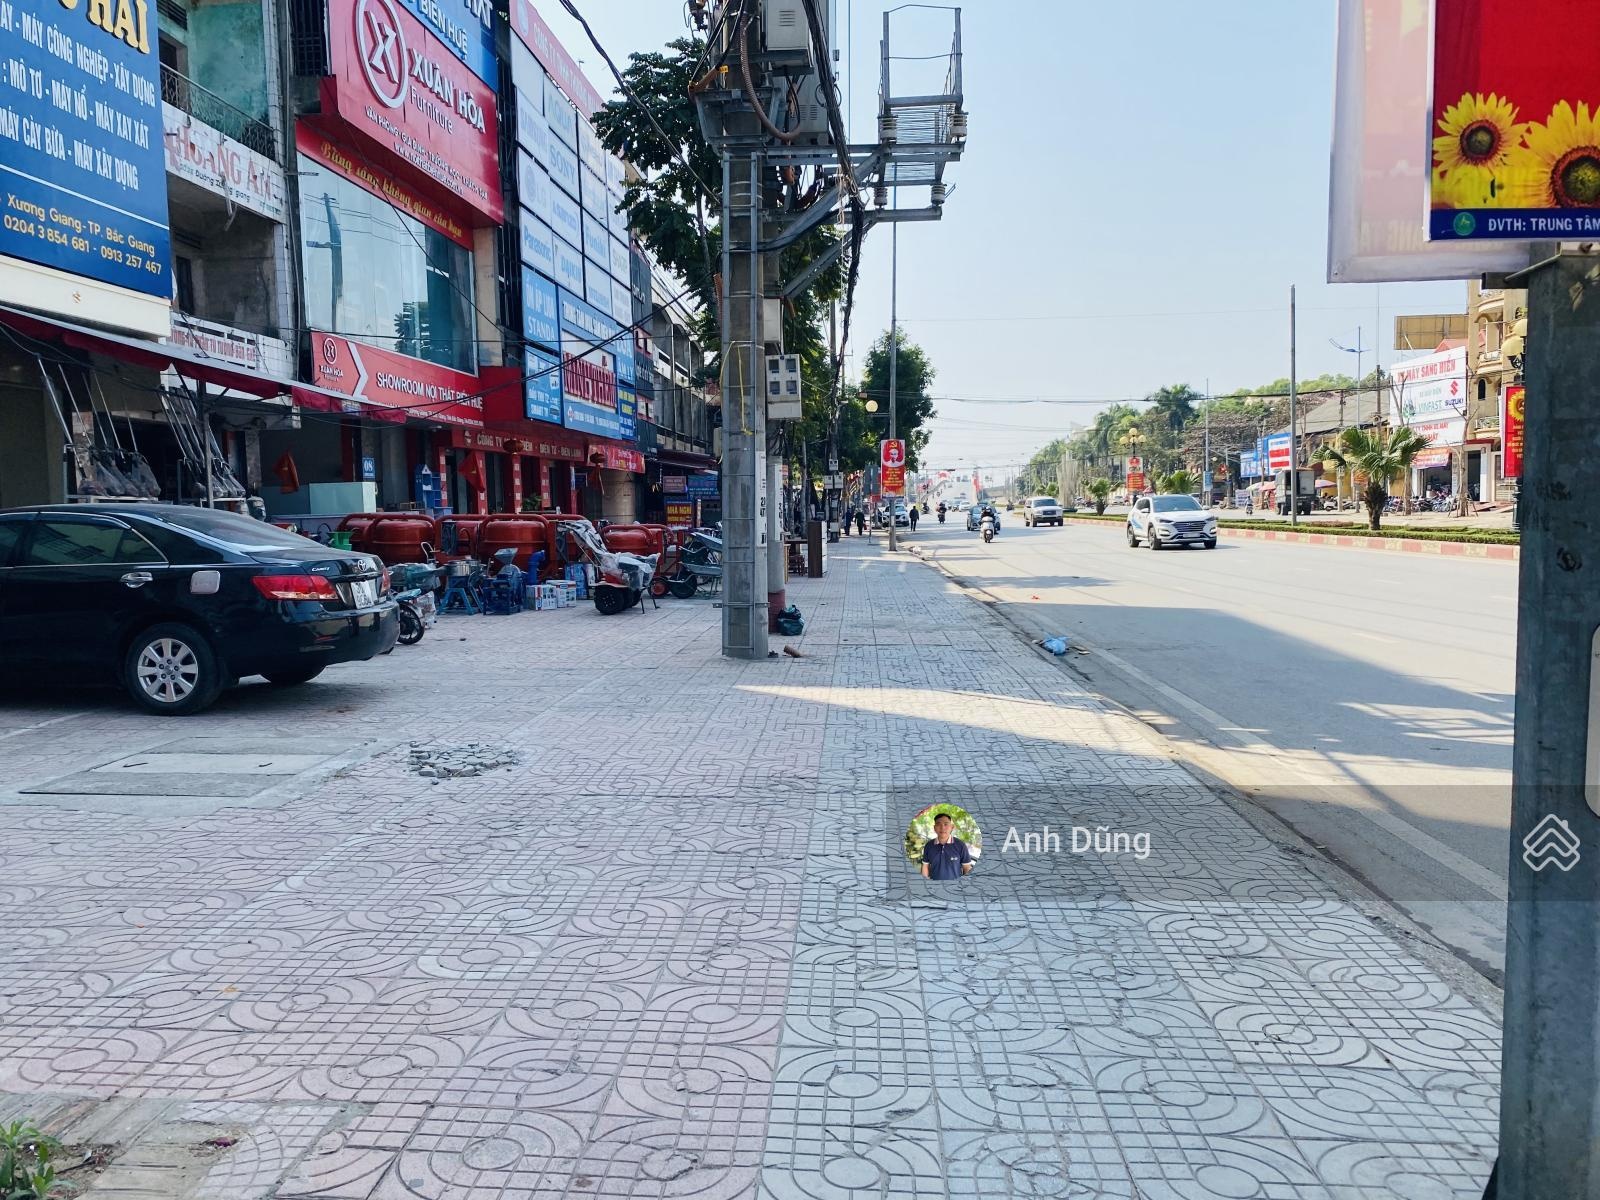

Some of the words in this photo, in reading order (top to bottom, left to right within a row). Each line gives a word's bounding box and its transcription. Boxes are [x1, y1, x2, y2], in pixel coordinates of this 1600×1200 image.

[21, 11, 43, 49] MÁY
[46, 23, 74, 65] CÔNG
[76, 42, 109, 85] NGHIỆP
[113, 61, 130, 94] XÂY
[132, 72, 156, 108] DỰNG
[9, 57, 27, 93] MÔ
[51, 78, 72, 114] MÁY
[73, 83, 88, 121] NỔ
[95, 100, 115, 134] MÁY
[115, 111, 133, 142] XAY
[133, 119, 149, 150] XÁT
[409, 84, 454, 135] Furniture
[411, 47, 454, 108] XUÂN
[457, 88, 486, 134] HÒA
[22, 114, 41, 151] CÀY
[44, 125, 66, 161] BỪA
[73, 138, 93, 172] MÁY
[95, 147, 113, 180] XÂY
[114, 159, 139, 191] DỰNG
[549, 144, 577, 186] SONY
[7, 192, 46, 222] Xương
[1488, 218, 1527, 232] ĐVTH:
[1530, 217, 1573, 231] TRUNG
[3, 213, 36, 237] 0204
[37, 225, 46, 240] 3
[46, 228, 69, 248] 854
[71, 236, 91, 253] 681
[100, 244, 124, 264] 0913
[125, 252, 143, 270] 257
[144, 258, 163, 277] 467
[527, 315, 556, 342] STANDA
[376, 371, 424, 397] SHOWROOM
[425, 384, 437, 403] NỘI
[1444, 398, 1464, 407] SUZUKI
[364, 460, 373, 472] 08
